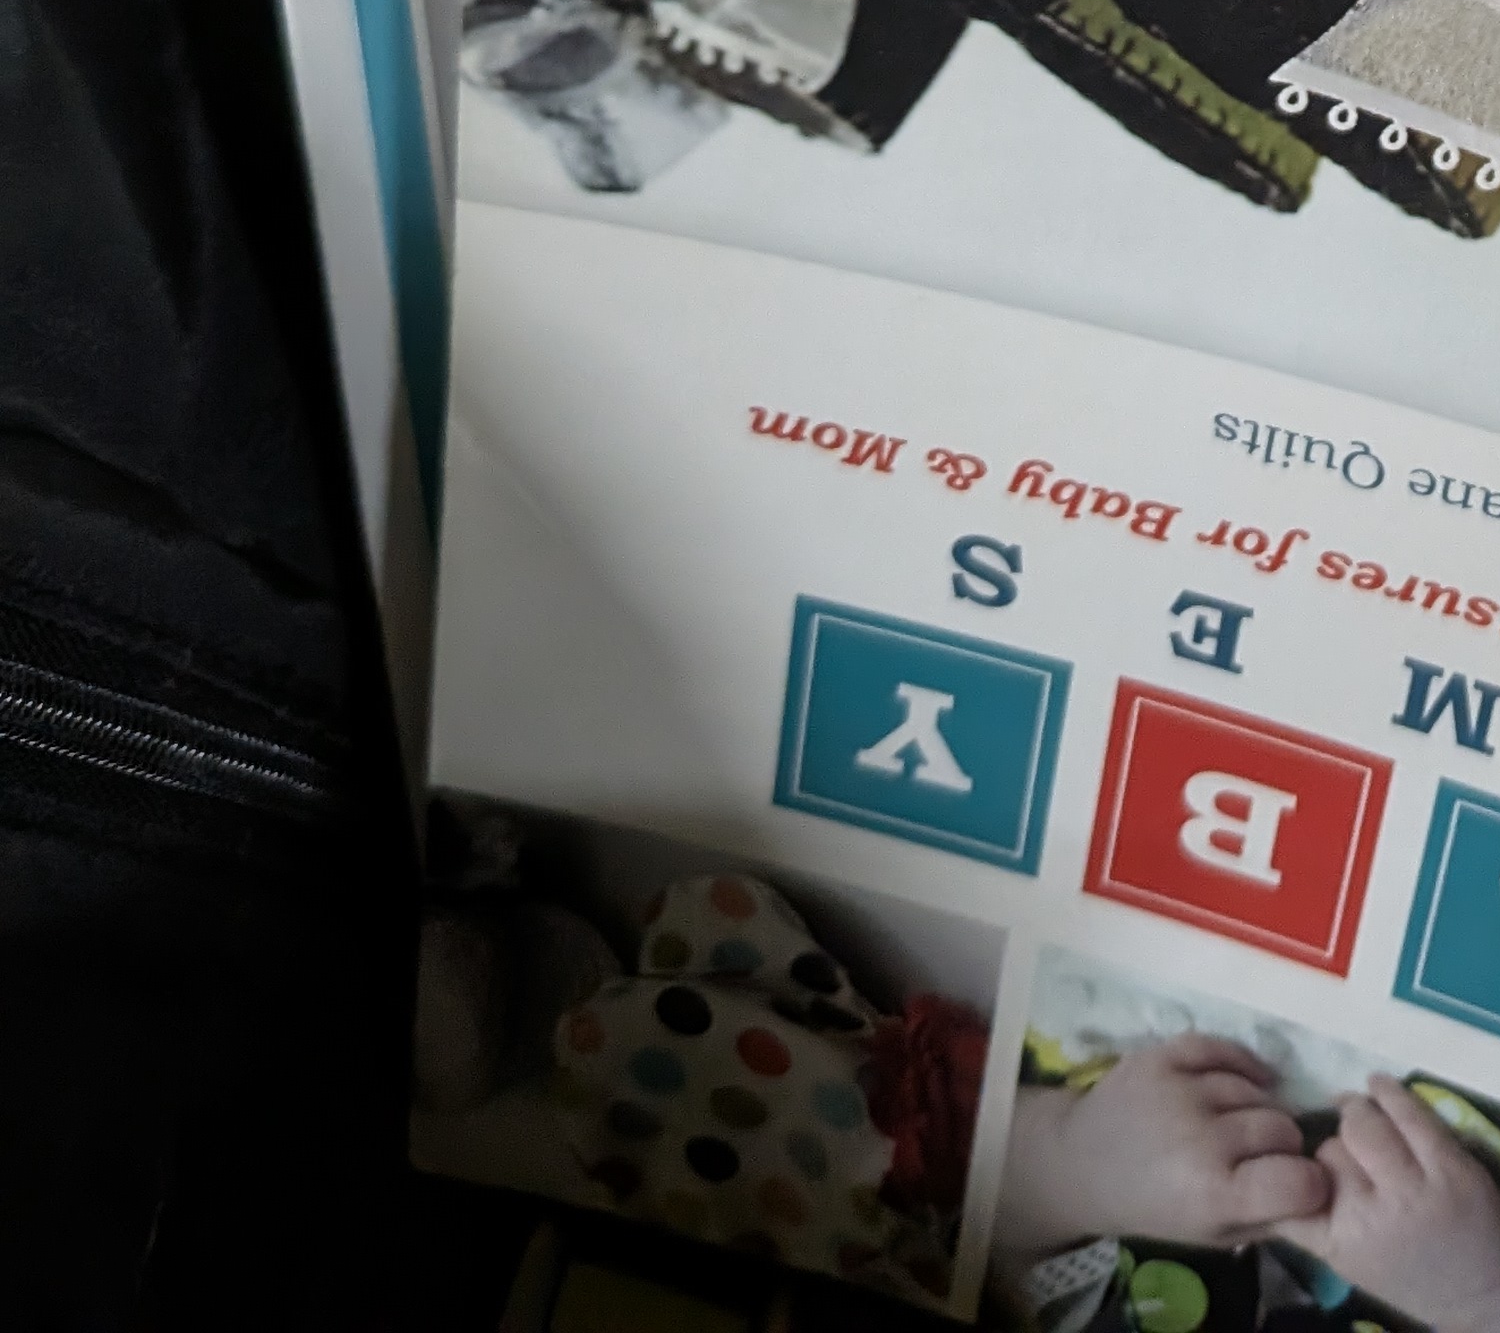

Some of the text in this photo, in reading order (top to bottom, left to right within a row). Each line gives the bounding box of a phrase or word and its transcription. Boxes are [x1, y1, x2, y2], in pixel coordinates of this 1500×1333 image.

[747, 405, 908, 474] Mom
[926, 447, 988, 491] &
[1212, 412, 1386, 491] Quilts
[1007, 459, 1183, 542] Baby
[1196, 519, 1311, 574] for
